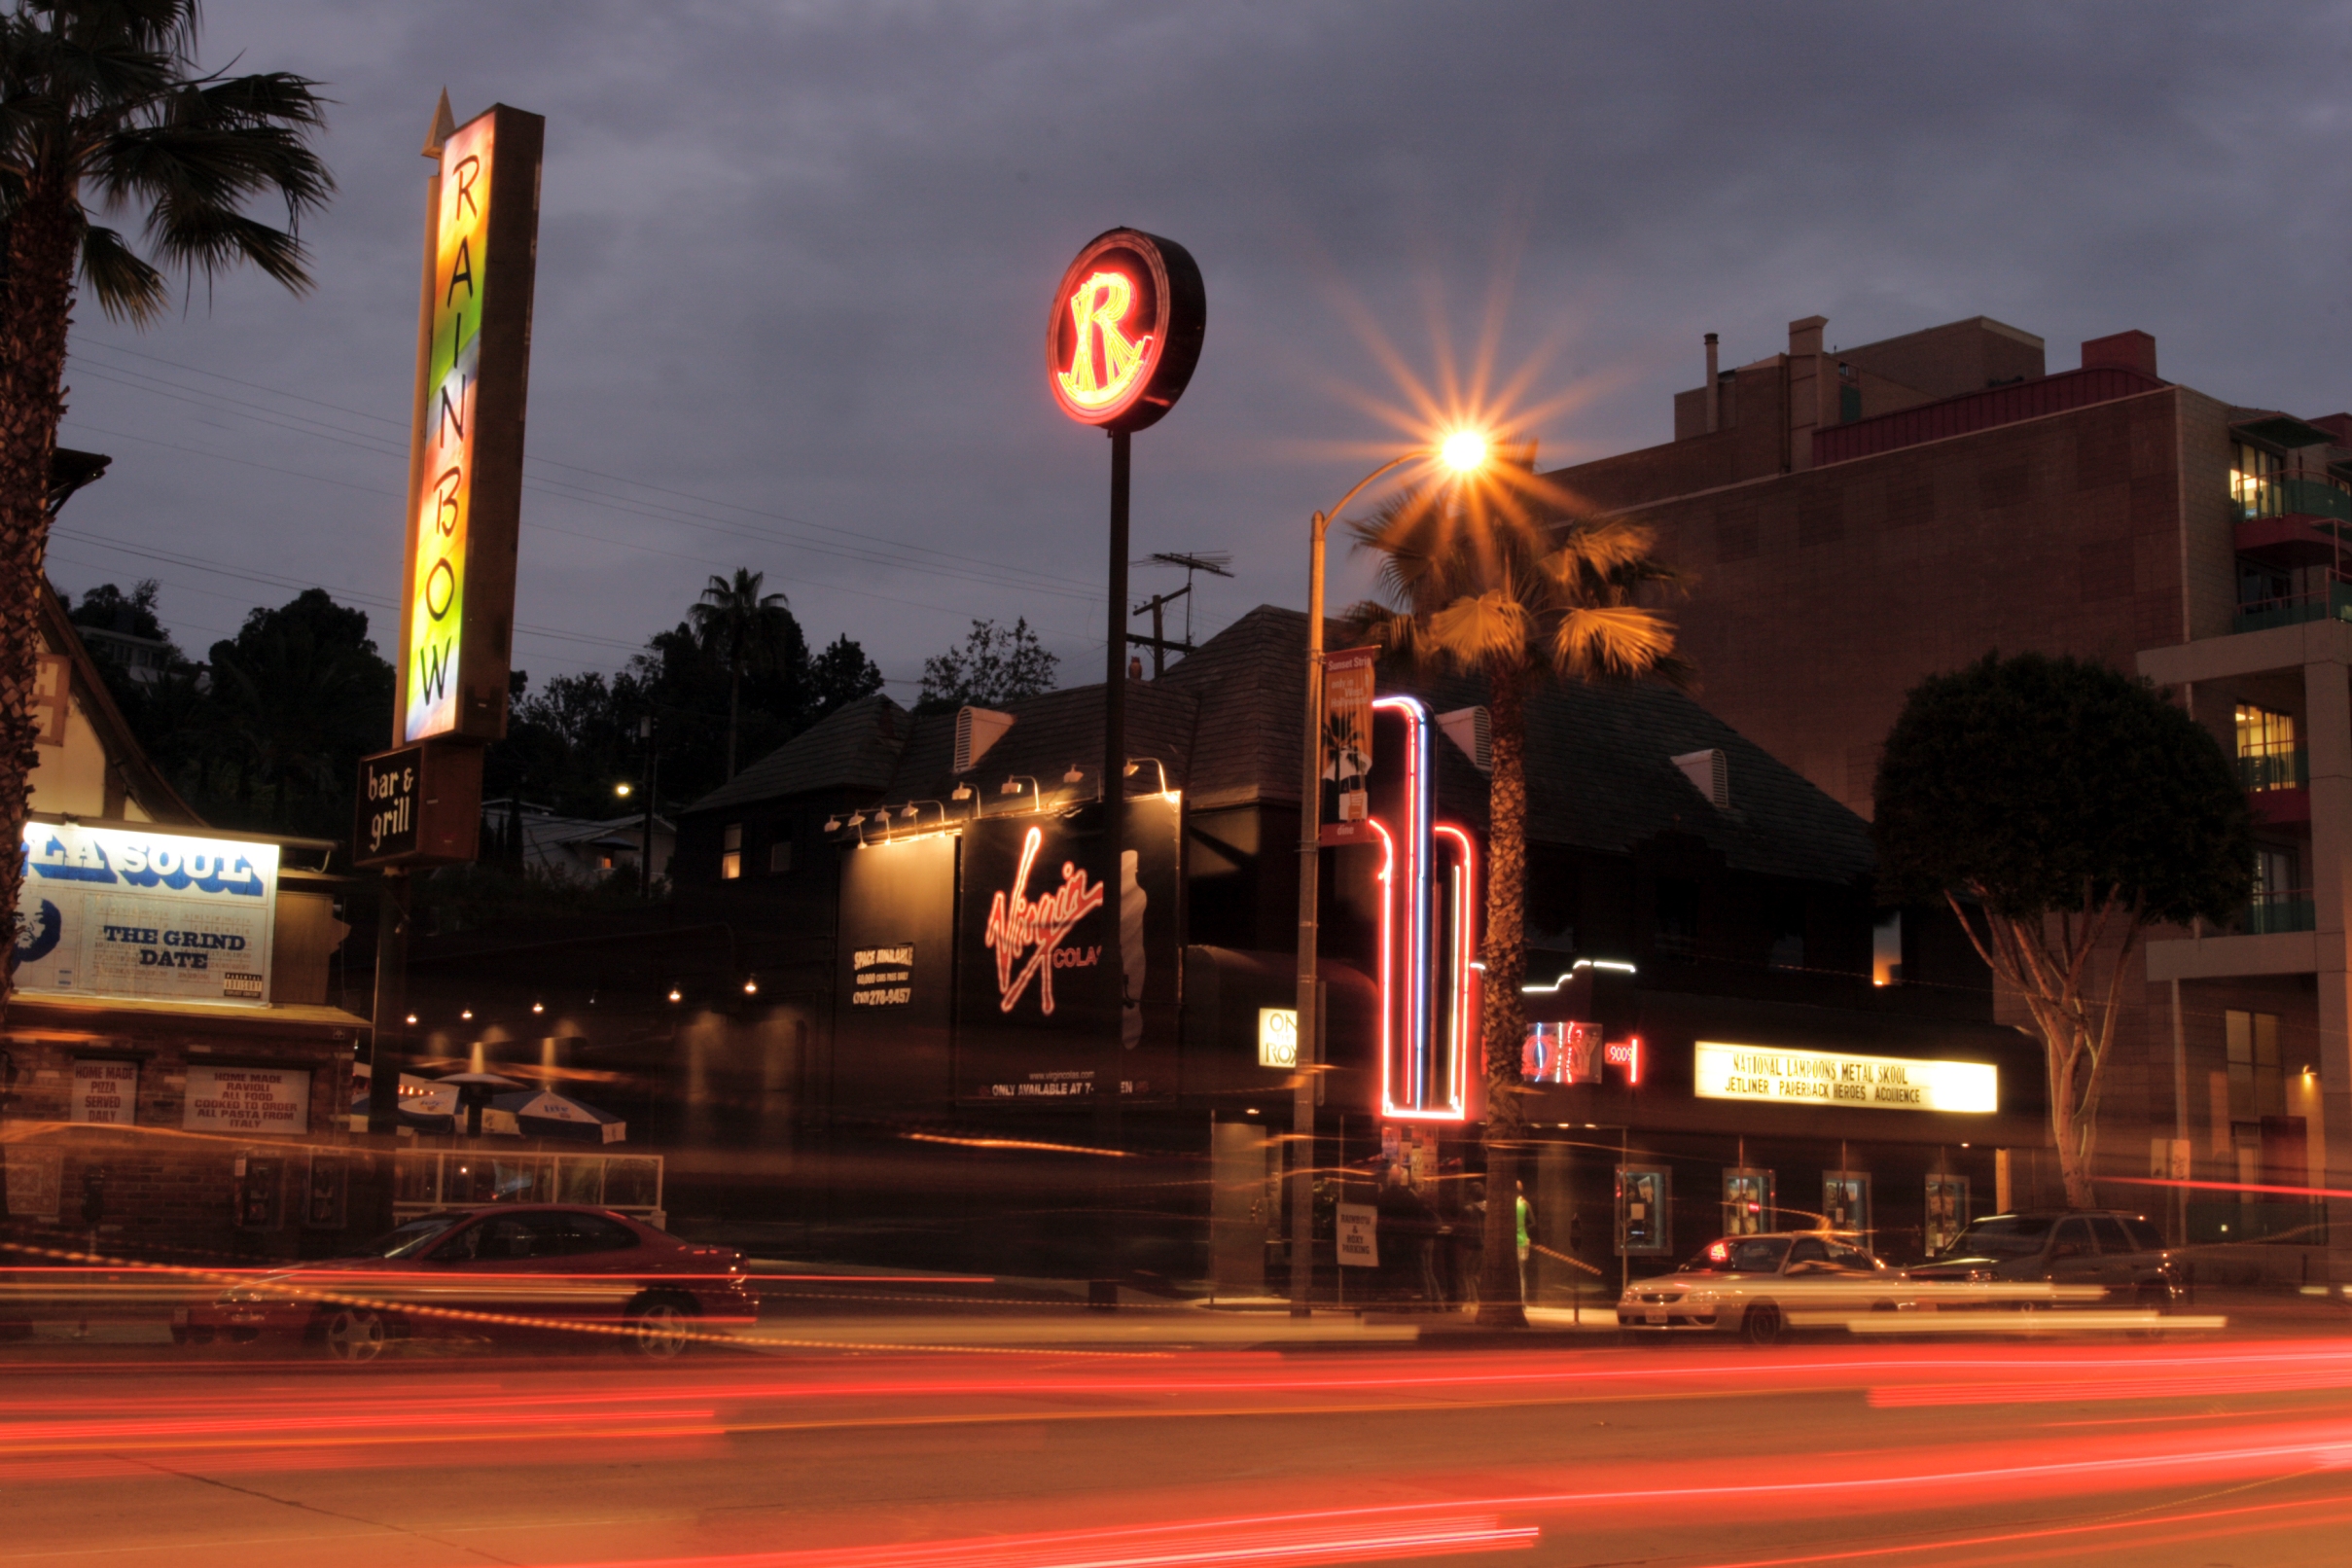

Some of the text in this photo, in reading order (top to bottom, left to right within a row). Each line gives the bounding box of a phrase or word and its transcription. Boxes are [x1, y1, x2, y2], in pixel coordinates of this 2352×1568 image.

[420, 155, 481, 706] RAINBOW
[1328, 655, 1372, 671] Sunset Strip
[369, 765, 413, 802] bar &
[370, 796, 410, 852] grill
[1337, 824, 1354, 836] dine
[119, 842, 264, 897] SOUL
[103, 925, 159, 945] THE
[163, 930, 246, 951] GRIND
[140, 949, 208, 969] DATE
[75, 1066, 133, 1081] HOME MADE
[1733, 1053, 1908, 1086] NATIONAL LAMPOONS METAL SKOOL
[214, 1072, 282, 1085] HOME MADE
[90, 1082, 117, 1094] PIZZA
[226, 1082, 270, 1092] RAVIOLI
[992, 1084, 1015, 1096] ONLY
[1018, 1083, 1068, 1096] AVAILABLE
[1070, 1082, 1083, 1095] AT
[1725, 1076, 1769, 1094] JETLINER
[1779, 1080, 1830, 1099] PAPERBACK
[1833, 1083, 1867, 1100] HEROES
[85, 1095, 121, 1109] SERVED
[222, 1090, 273, 1101] ALL FOOD
[195, 1099, 298, 1112] COOKED TO ORDER
[89, 1110, 116, 1123] DAILY
[197, 1108, 294, 1121] ALL PASTA FROM
[230, 1119, 262, 1128] ITALY
